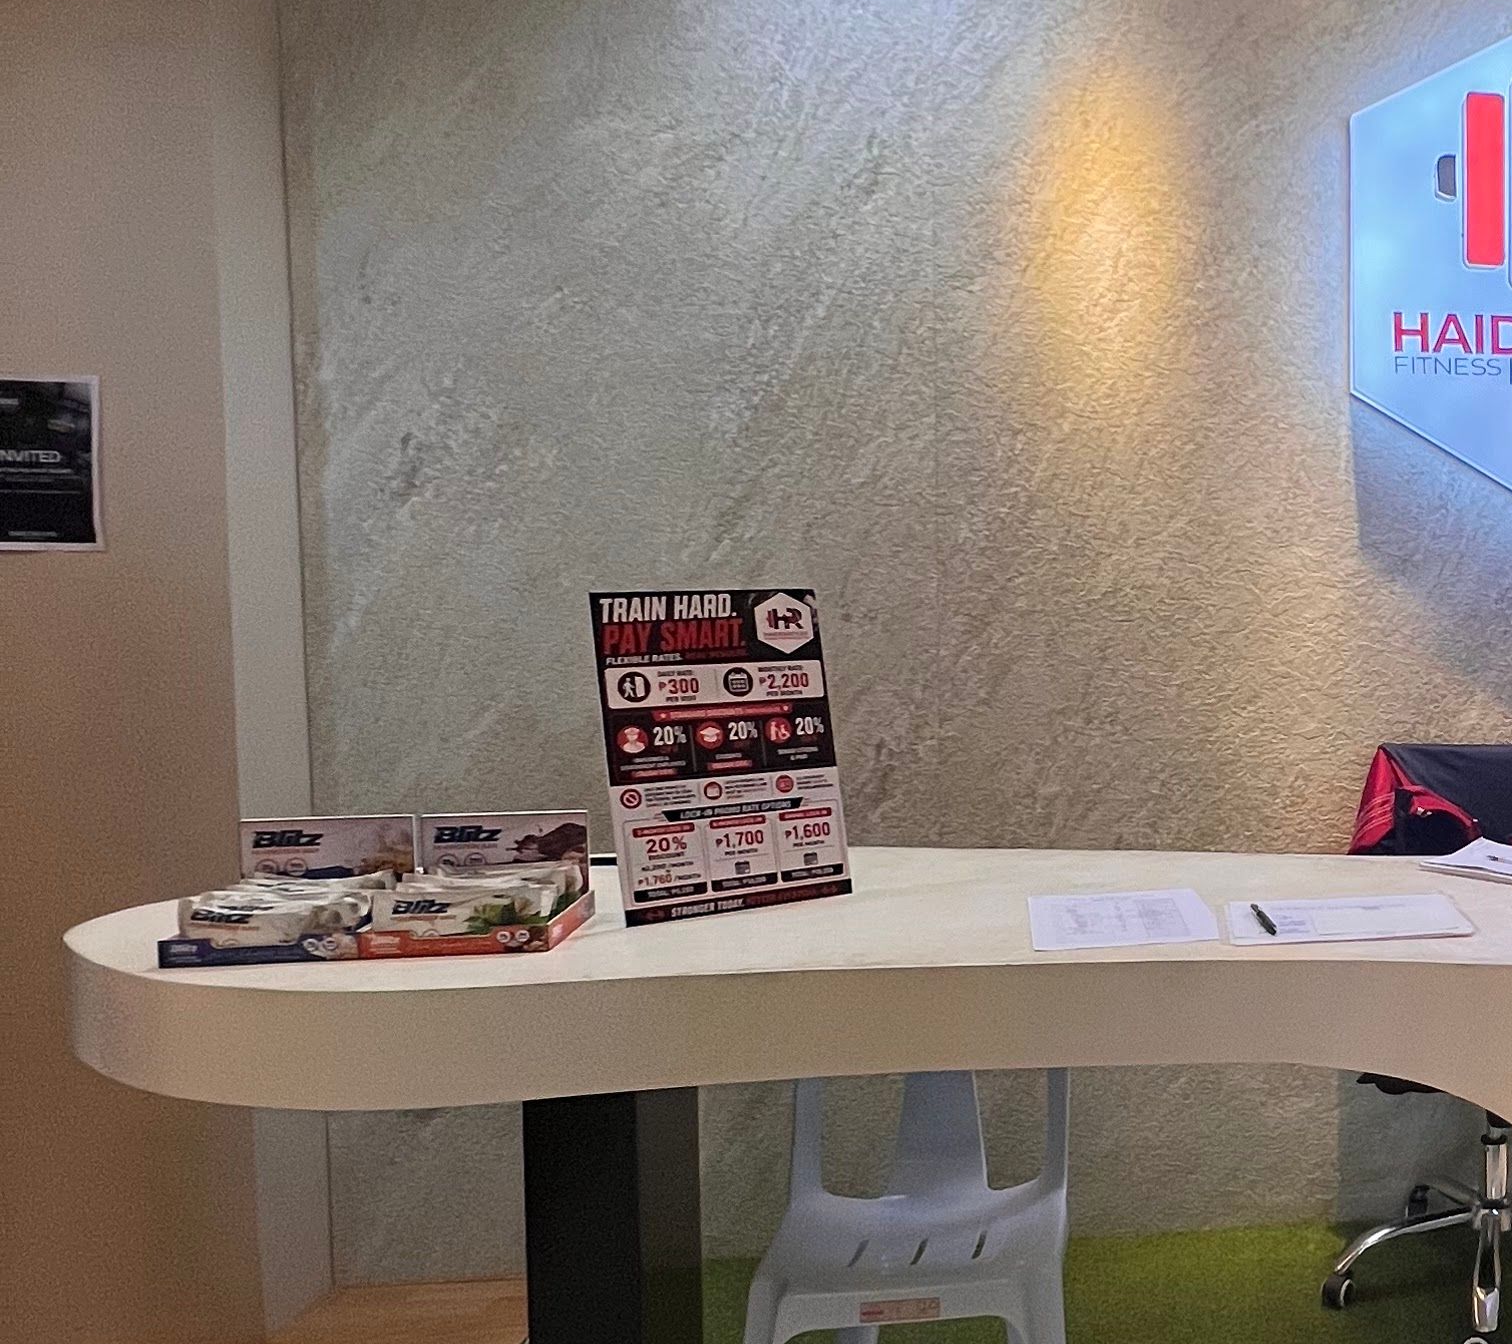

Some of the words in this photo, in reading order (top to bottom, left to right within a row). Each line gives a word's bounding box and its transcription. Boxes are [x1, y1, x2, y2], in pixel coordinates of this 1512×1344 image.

[1394, 356, 1502, 376] FITNESS
[600, 596, 667, 624] TRAIN
[673, 593, 737, 620] HARD.
[603, 623, 652, 655] PAY
[660, 618, 746, 652] SMART.
[652, 725, 687, 746] 20%
[728, 720, 758, 741] 20%
[795, 716, 825, 736] 20%
[646, 836, 688, 854] 20%
